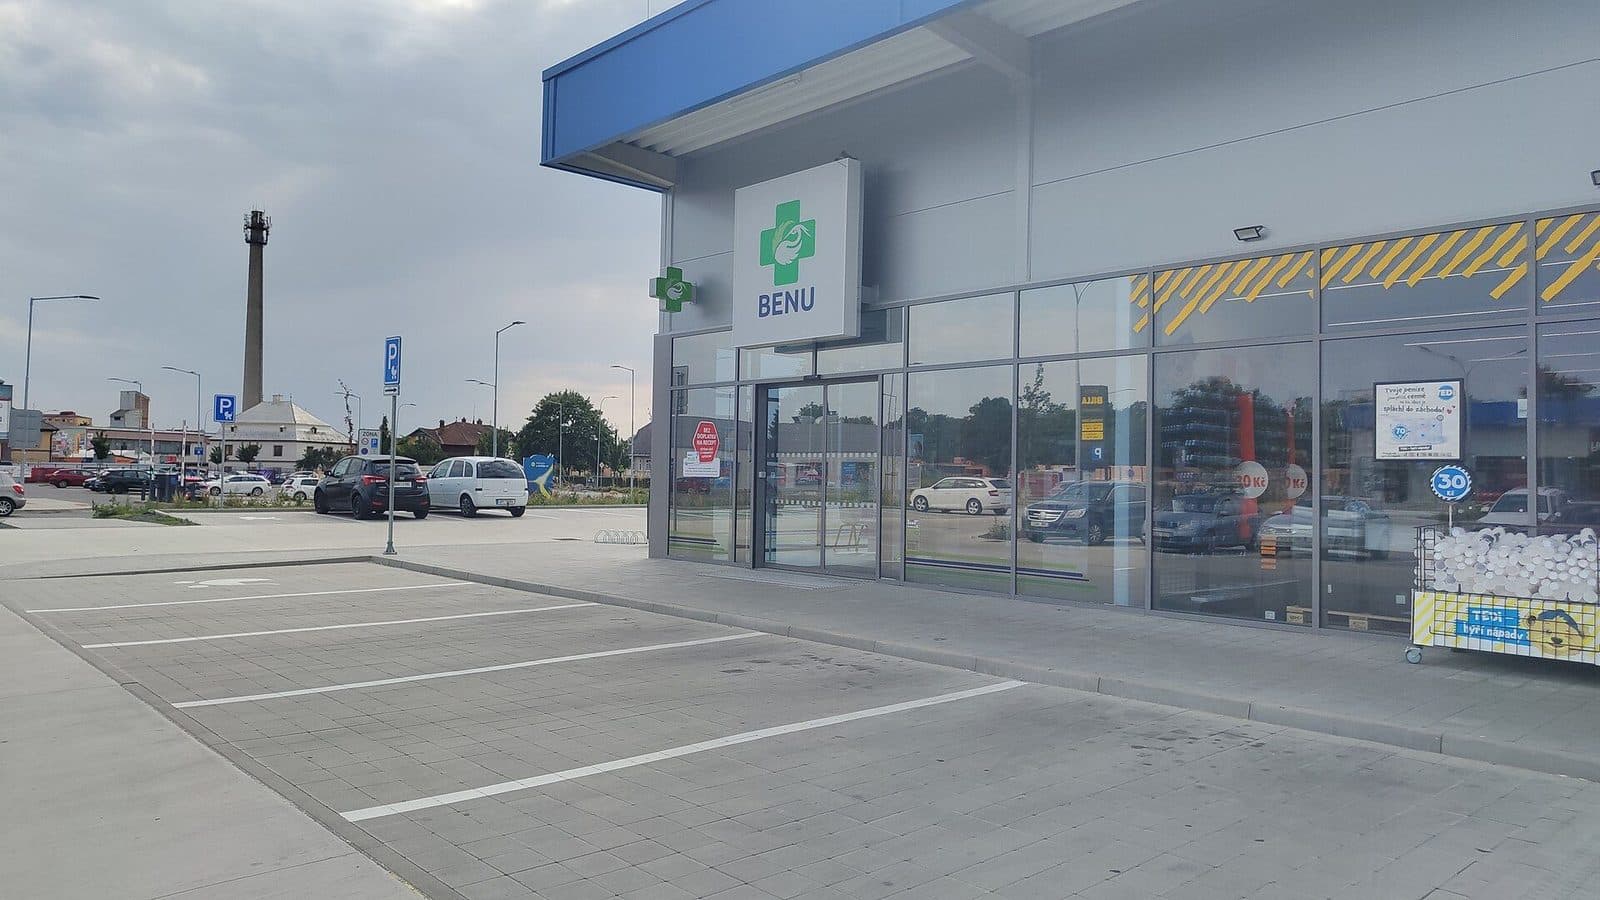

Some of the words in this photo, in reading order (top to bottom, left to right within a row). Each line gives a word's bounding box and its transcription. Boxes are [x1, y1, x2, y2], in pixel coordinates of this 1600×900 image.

[758, 286, 815, 318] BENU
[388, 343, 397, 370] P
[220, 398, 232, 414] P
[1253, 476, 1266, 488] Kč
[1438, 473, 1466, 489] 30
